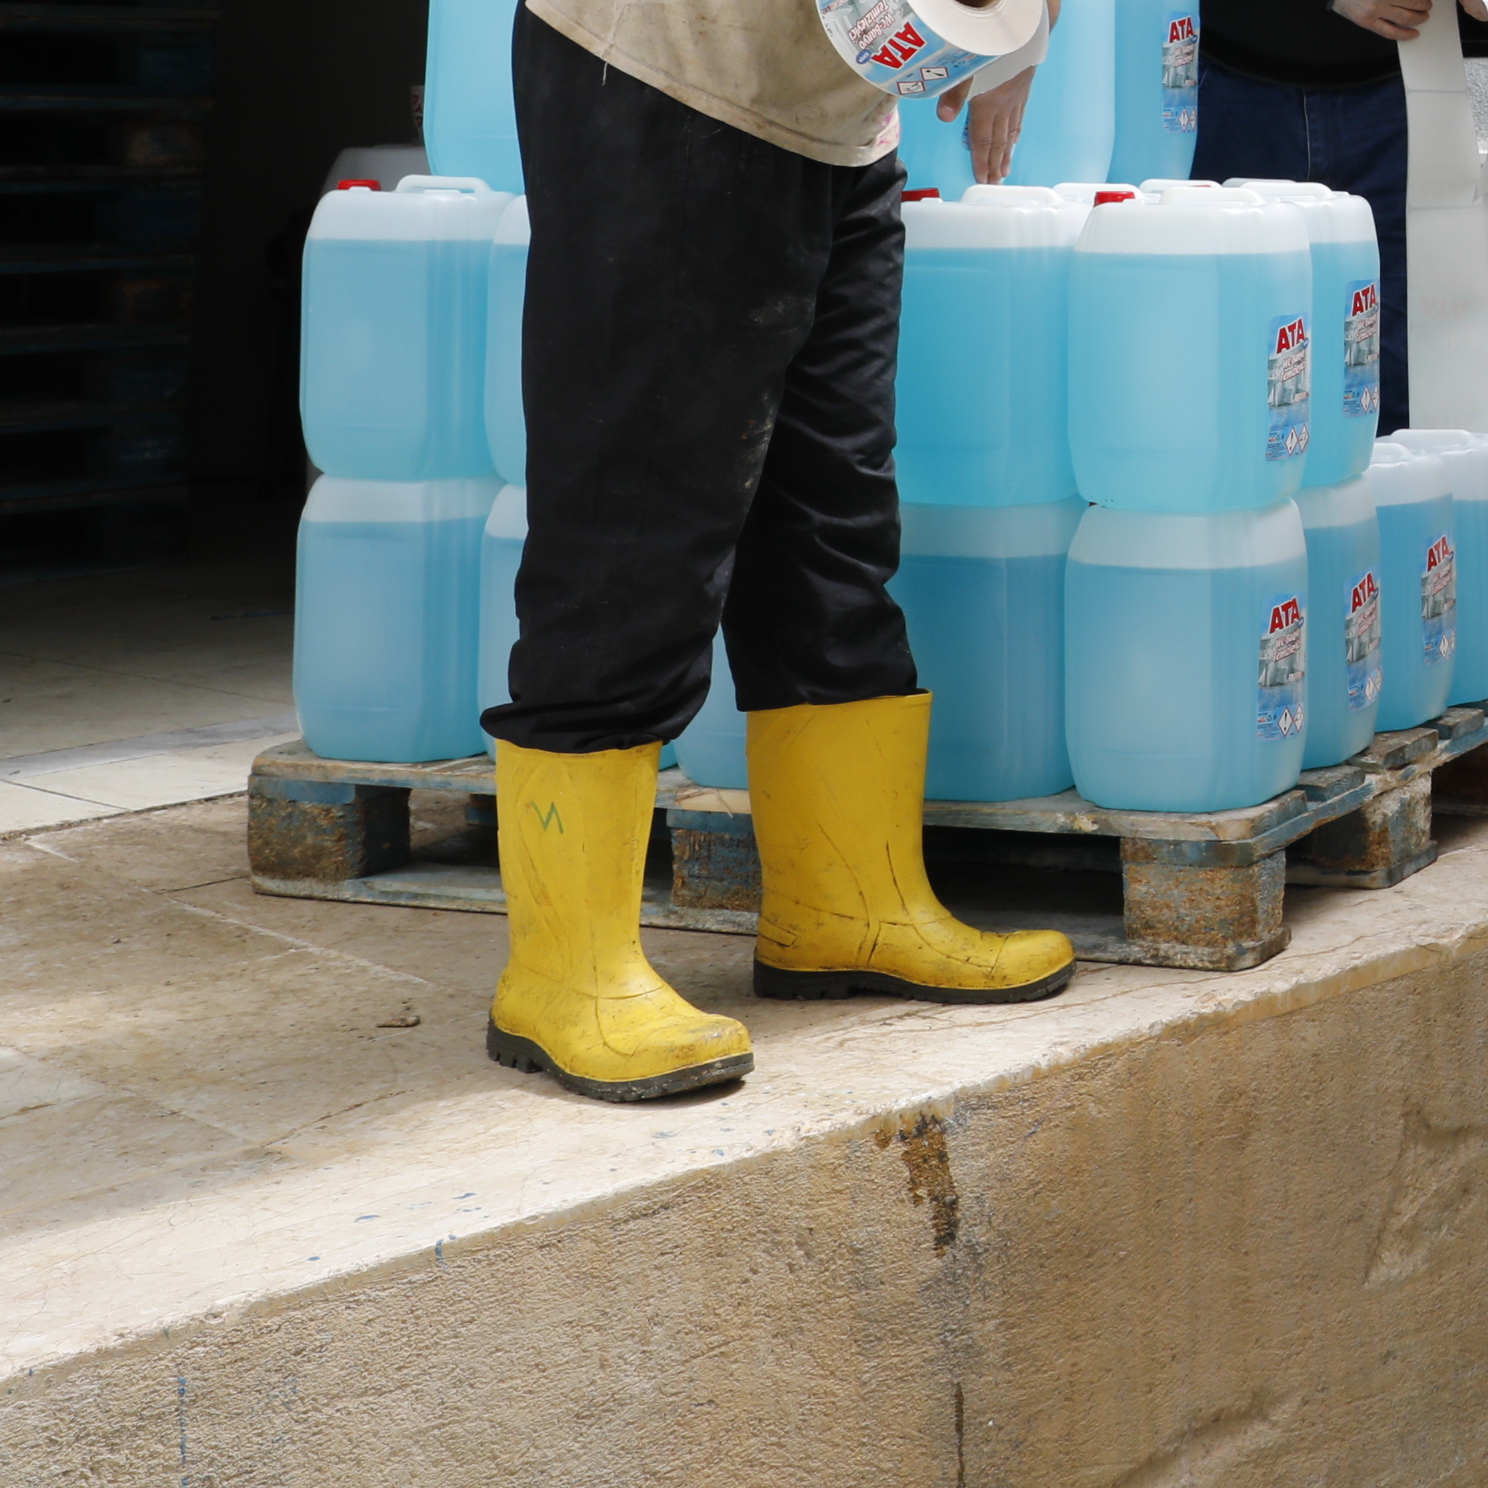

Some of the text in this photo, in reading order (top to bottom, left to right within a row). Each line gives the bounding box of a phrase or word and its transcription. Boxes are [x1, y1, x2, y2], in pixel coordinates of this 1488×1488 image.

[870, 21, 926, 69] ATA
[1168, 16, 1195, 44] ATA
[1351, 283, 1377, 317] ATA
[1275, 317, 1306, 354] ATA
[1427, 535, 1450, 573] ATA
[1351, 572, 1376, 614] ATA
[1268, 596, 1301, 634] ATA
